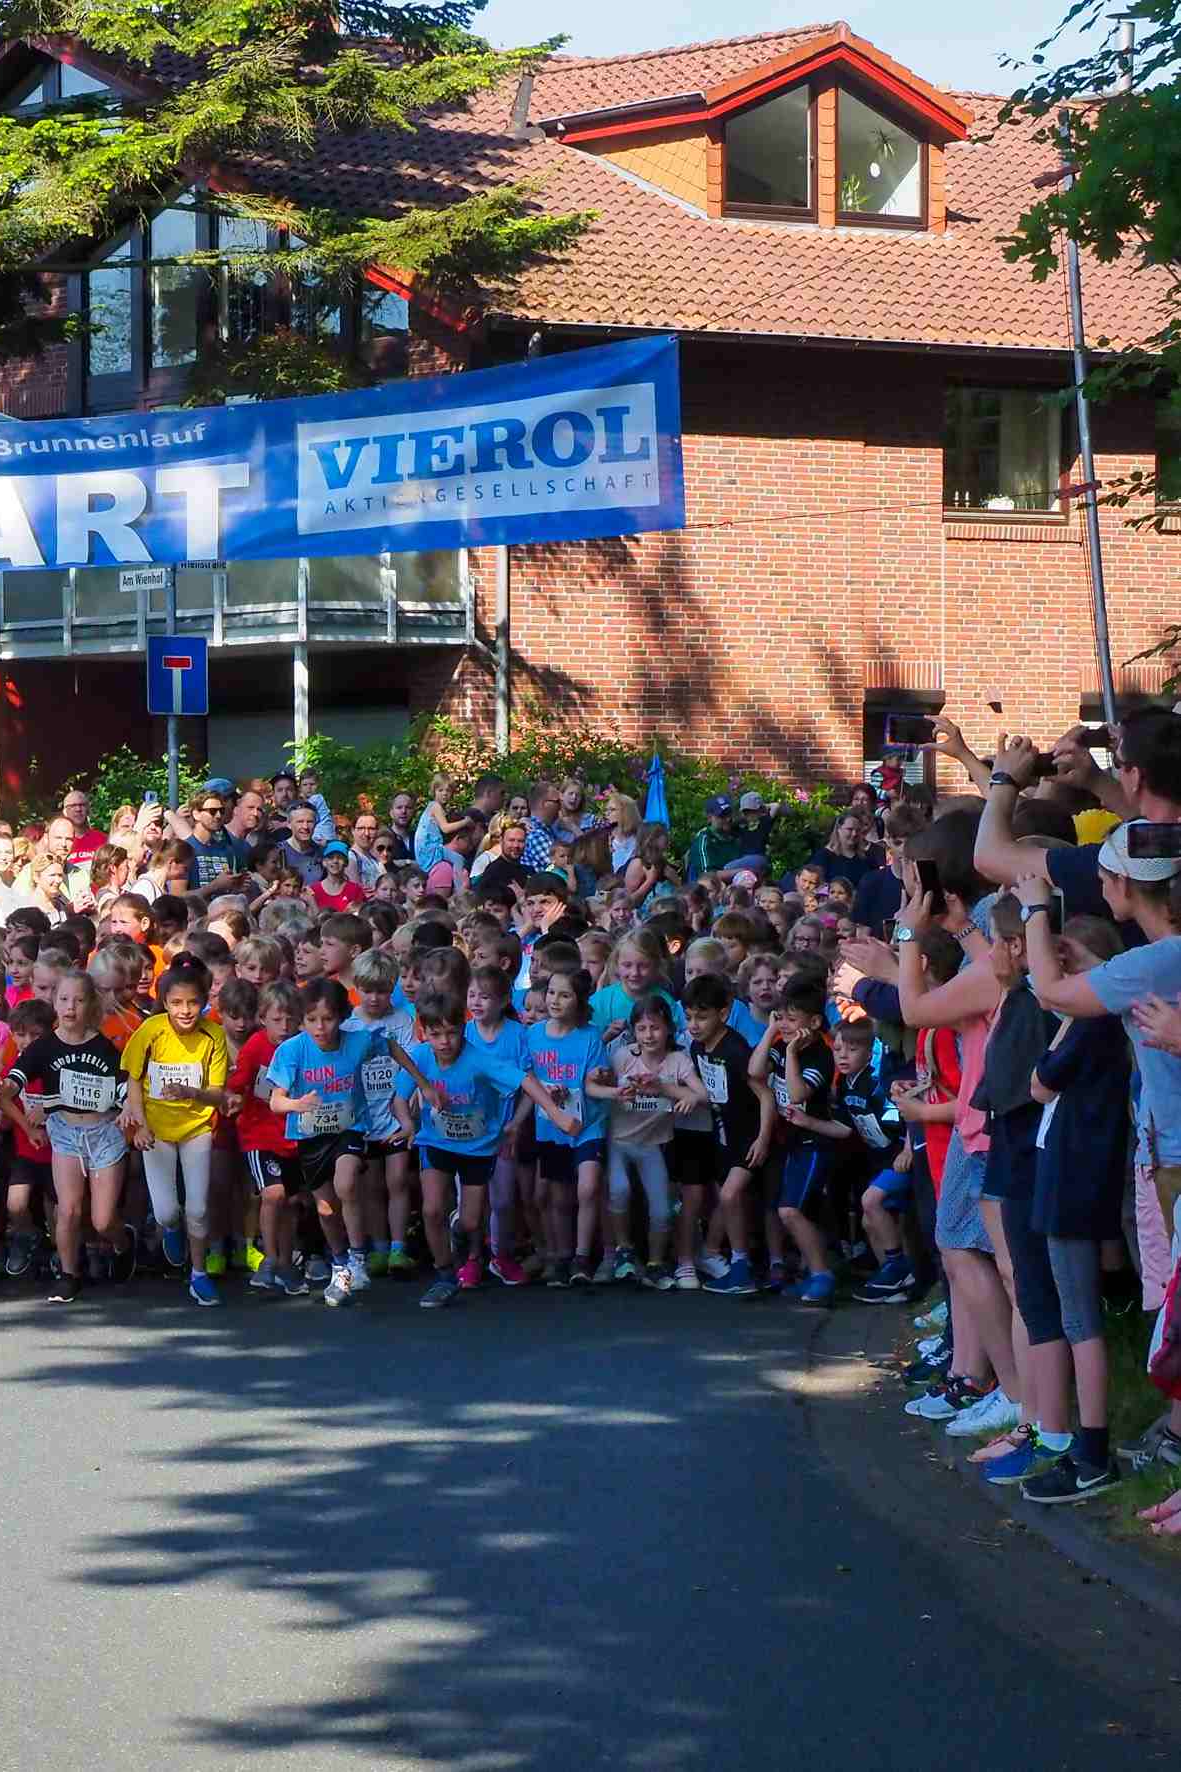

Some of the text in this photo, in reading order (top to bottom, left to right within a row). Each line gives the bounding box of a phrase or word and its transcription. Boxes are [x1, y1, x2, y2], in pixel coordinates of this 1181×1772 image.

[307, 404, 651, 490] VIEROL
[324, 472, 652, 514] AKTIGESELLSCHAFT
[123, 571, 163, 586] Am Wienhof
[364, 1070, 393, 1081] 1120
[73, 1085, 101, 1099] 1116
[366, 1080, 393, 1091] bruns
[73, 1095, 99, 1108] bruns
[314, 1113, 339, 1124] 734
[313, 1123, 340, 1134] bruns
